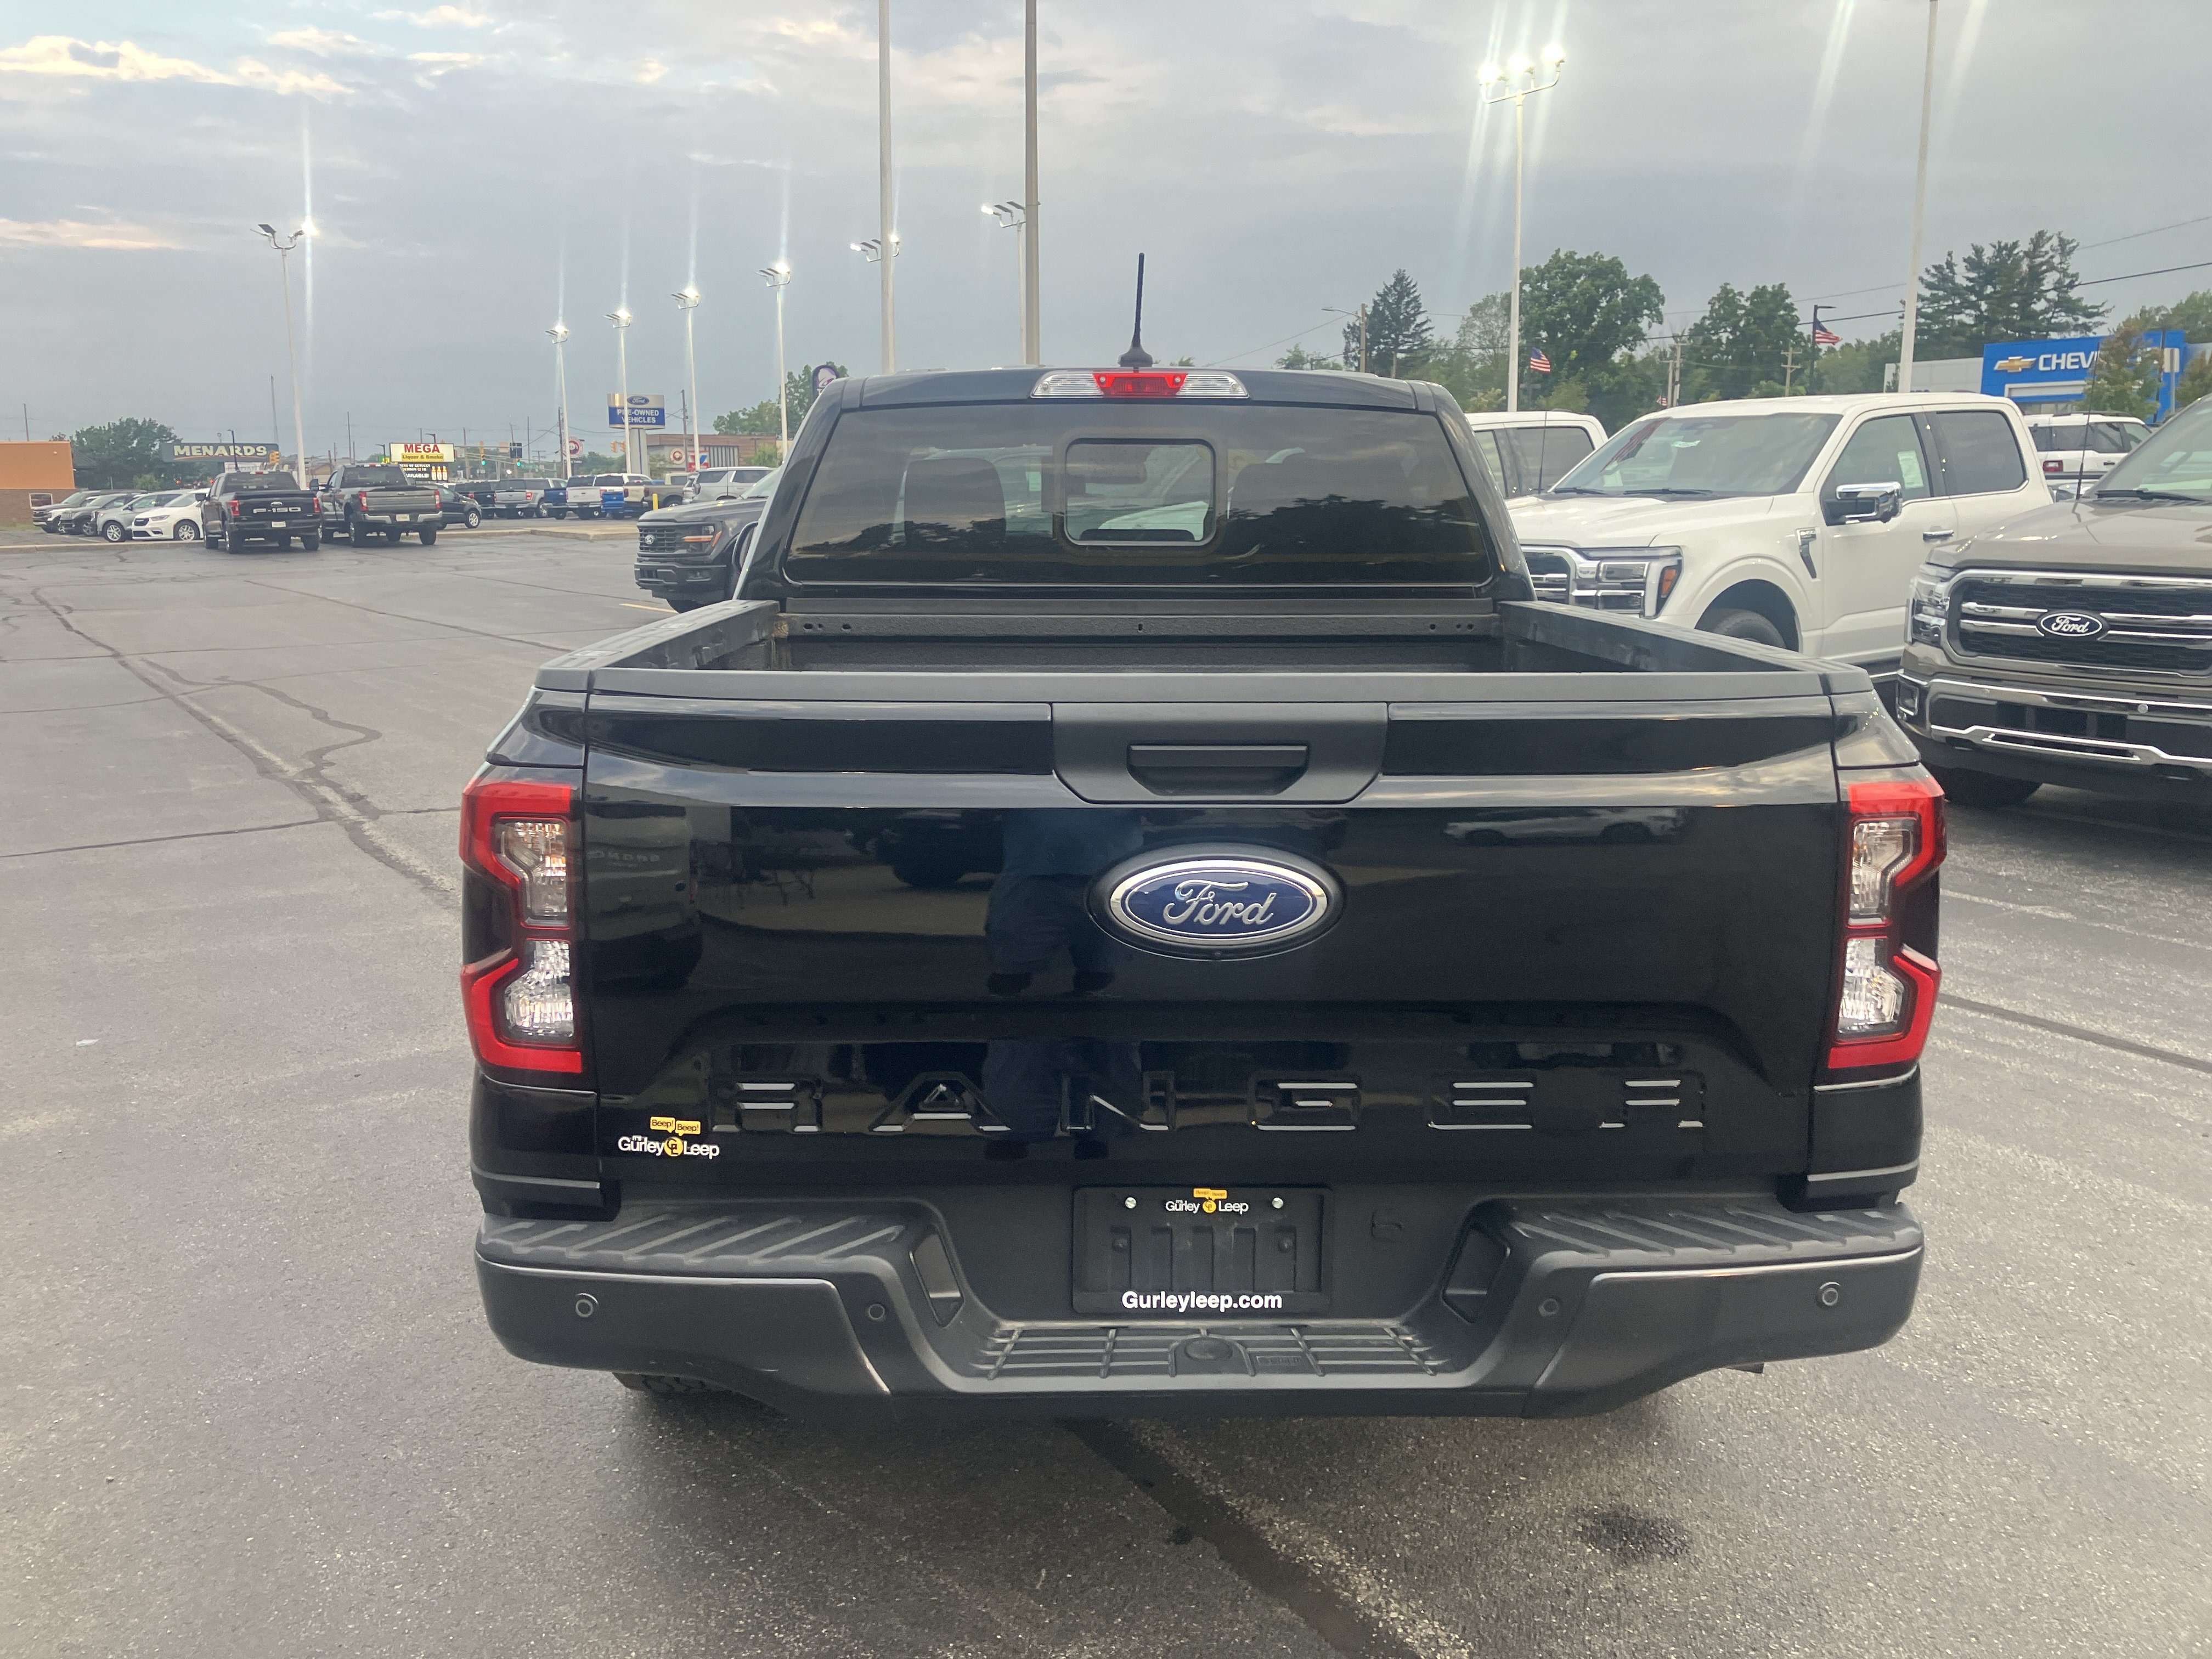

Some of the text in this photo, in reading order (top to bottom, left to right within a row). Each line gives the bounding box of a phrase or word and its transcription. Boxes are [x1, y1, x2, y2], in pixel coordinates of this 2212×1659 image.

[2038, 350, 2101, 371] CHEV
[173, 445, 268, 456] MENARDS
[404, 443, 440, 453] MEGA
[2051, 615, 2089, 634] Ford
[1163, 879, 1278, 926] Ford
[652, 1119, 699, 1132] Beep! Beep!
[618, 1136, 665, 1156] Gurley
[683, 1141, 720, 1159] Leep
[1165, 1200, 1200, 1214] Gurley
[1218, 1200, 1249, 1215] Leep
[1122, 1291, 1282, 1313] Gurleyleep.com
